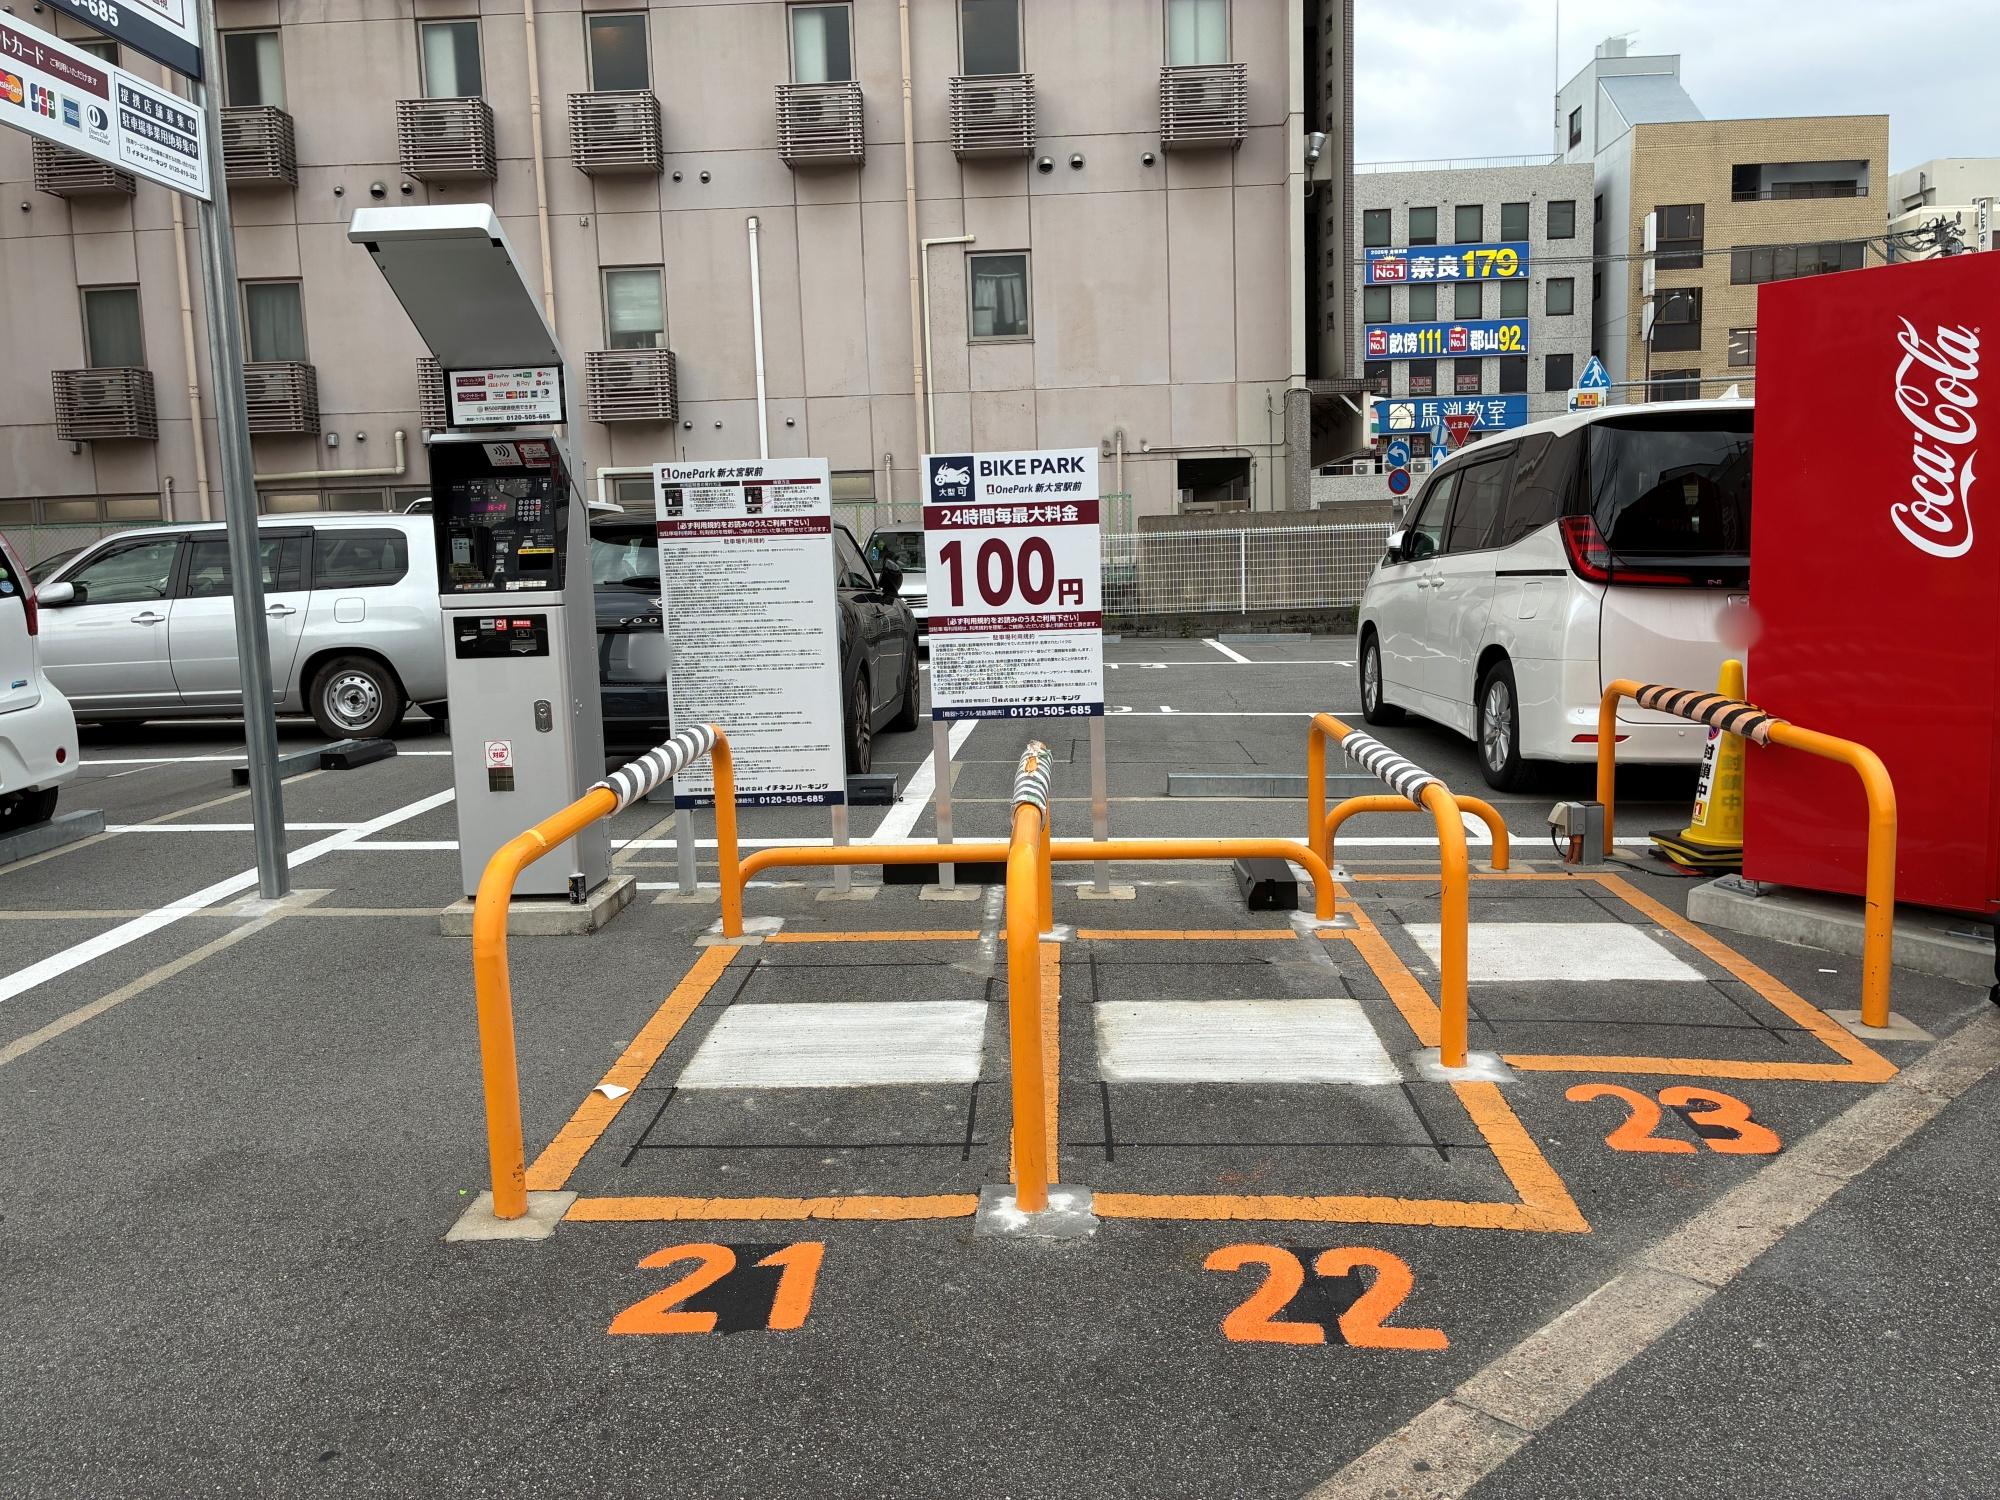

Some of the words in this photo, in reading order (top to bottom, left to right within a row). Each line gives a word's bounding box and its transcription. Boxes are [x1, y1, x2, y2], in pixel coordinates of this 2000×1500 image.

[0, 30, 44, 65] トカード
[49, 57, 98, 86] ご利用いただけます
[30, 93, 55, 111] JCB
[120, 87, 195, 133] 提携店舗募集中
[121, 111, 197, 156] 駐車場事業用地募集中
[1375, 264, 1403, 278] No.1
[1451, 421, 1470, 429] 止まれ
[1890, 315, 1980, 558] Coca-Cola
[671, 468, 716, 480] OnePark
[717, 467, 763, 478] 新大宮駅前
[980, 459, 1026, 477] BIKE
[1031, 456, 1085, 475] PARK
[995, 483, 1033, 494] OnePark
[1035, 481, 1082, 493] 新大宮駅前
[941, 504, 1078, 526] 24時間毎最大料金
[1010, 705, 1091, 717] 0120-505-685
[759, 794, 824, 804] 0120-505-685
[1565, 1083, 1782, 1155] 23
[608, 1241, 825, 1335] 21
[1203, 1243, 1450, 1350] 22
